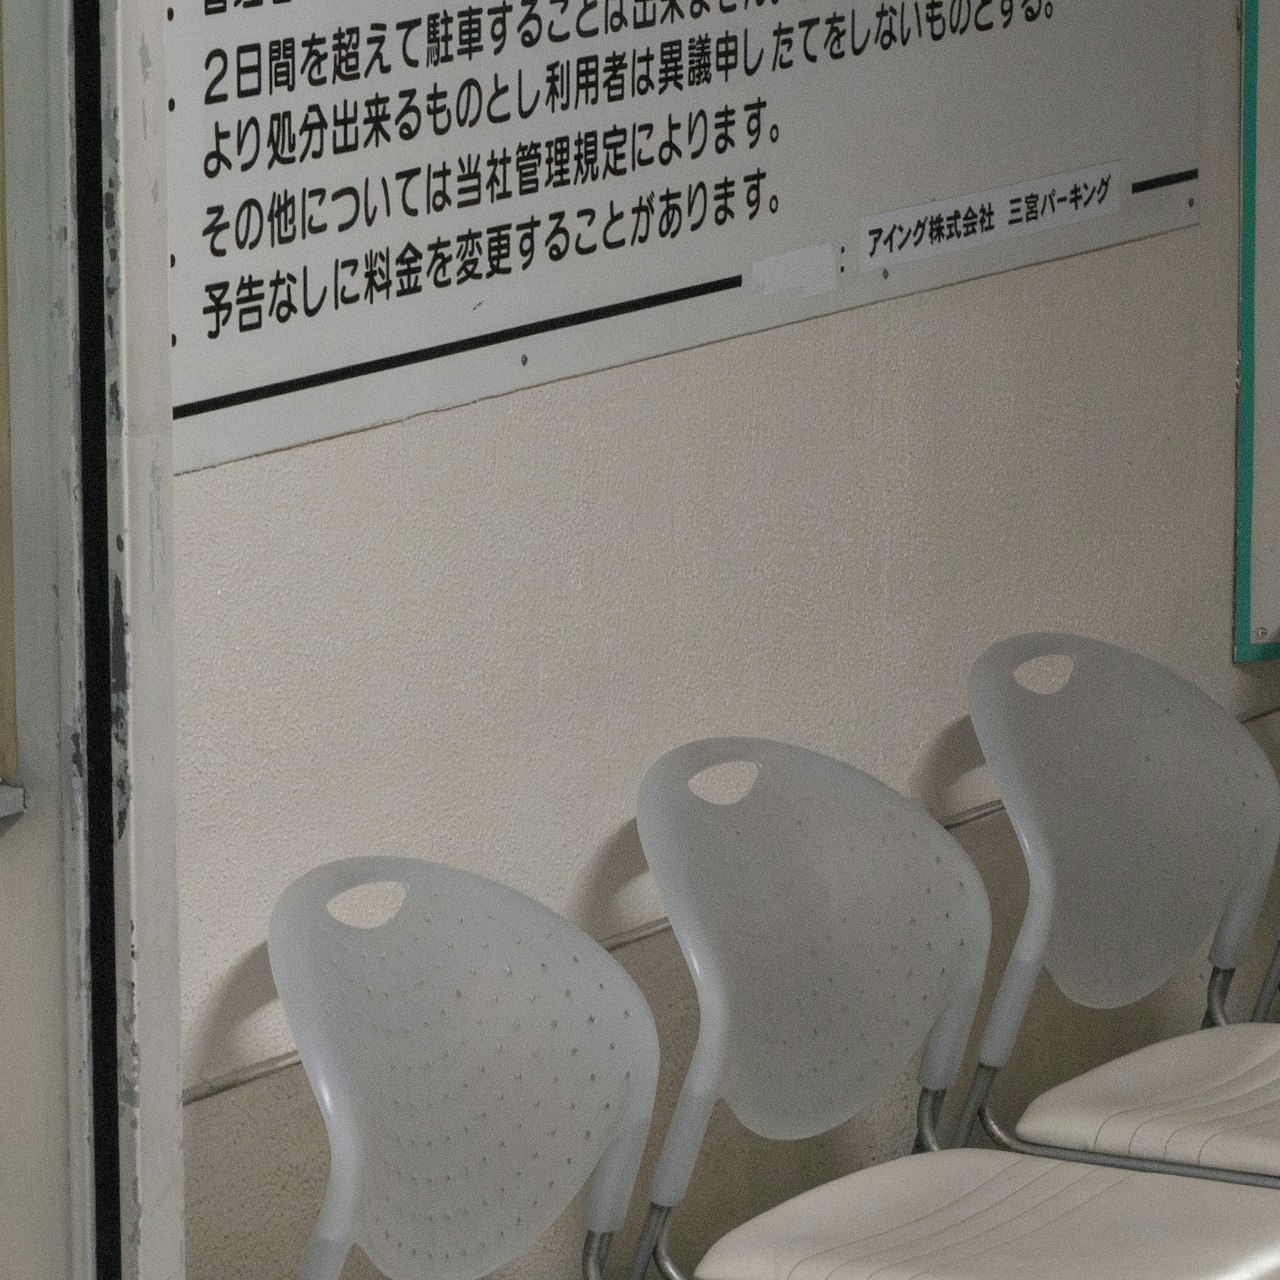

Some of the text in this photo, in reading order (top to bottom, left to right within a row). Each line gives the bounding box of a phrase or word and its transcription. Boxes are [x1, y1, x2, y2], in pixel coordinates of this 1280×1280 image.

[202, 97, 779, 258] その他については当社管理規定によります。
[202, 168, 779, 339] 予告なしに料金を変更することがあります。
[868, 174, 1112, 258] アイング株式会社 三宮パーキング
